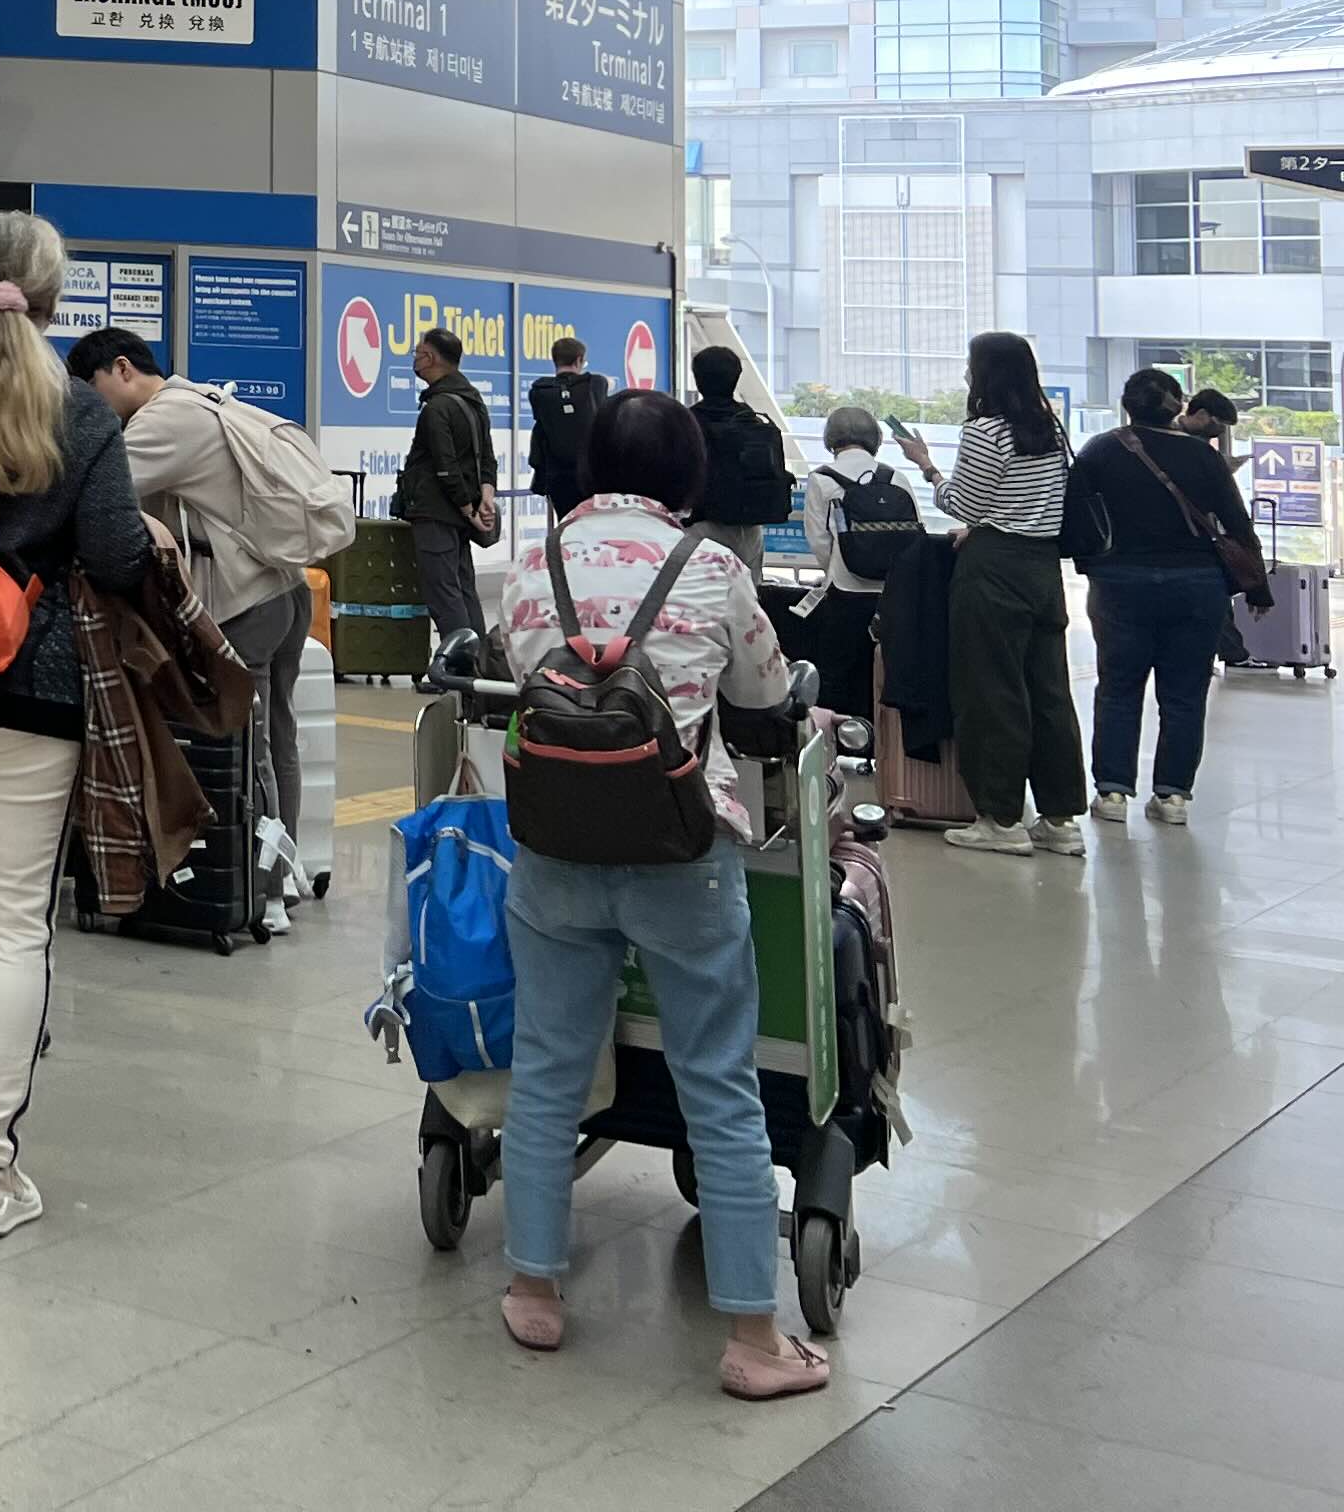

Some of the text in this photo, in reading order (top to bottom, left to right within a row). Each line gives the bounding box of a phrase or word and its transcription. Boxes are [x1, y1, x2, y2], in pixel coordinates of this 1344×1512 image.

[91, 11, 124, 27] 교환
[439, 4, 447, 36] 1
[426, 47, 483, 84] 제1터미널
[592, 40, 665, 90] Terminal 2
[50, 312, 72, 326] AIL
[73, 313, 102, 328] PASS
[388, 293, 439, 356] JR
[443, 306, 506, 357] Ticket
[1294, 451, 1314, 462] T2
